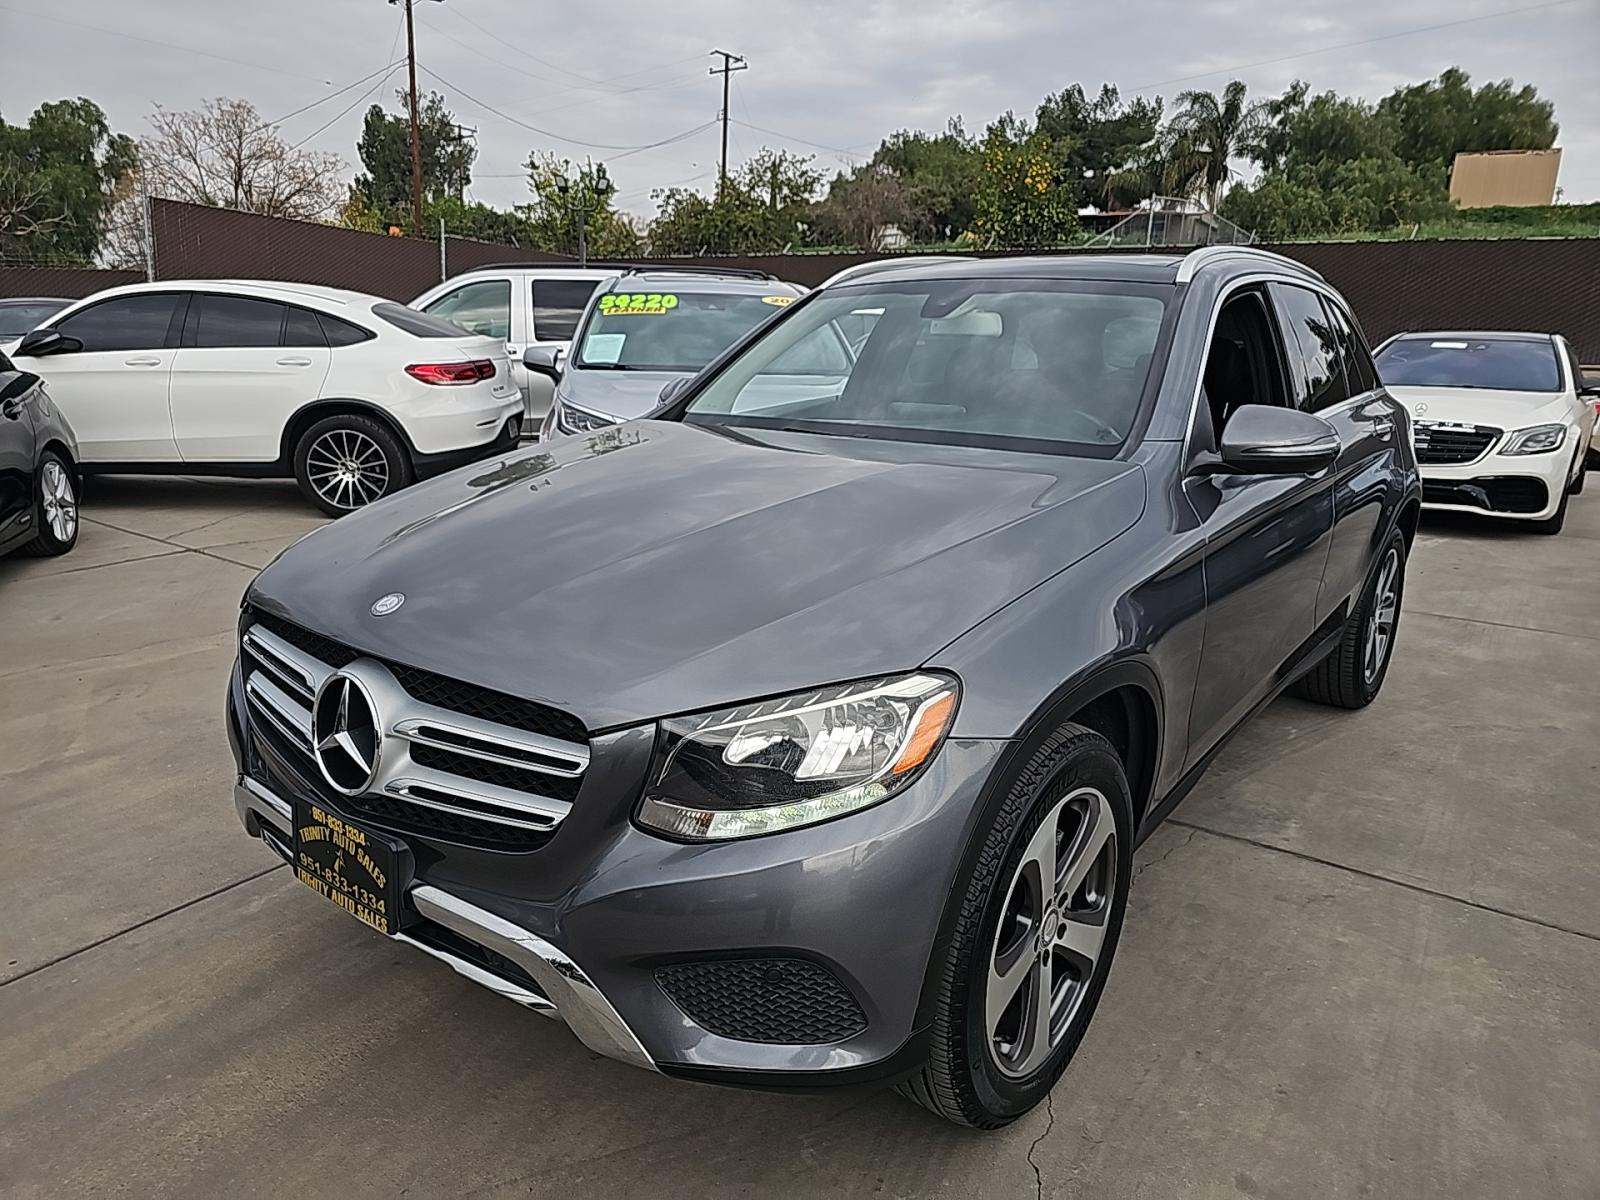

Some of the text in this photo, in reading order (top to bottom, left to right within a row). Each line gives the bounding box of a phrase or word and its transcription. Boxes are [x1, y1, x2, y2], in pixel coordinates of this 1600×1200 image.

[299, 825, 387, 889] TRINITY AUTO SALES
[300, 852, 385, 914] 951-833-1334
[297, 867, 388, 933] TRINITY AUTO SALES
